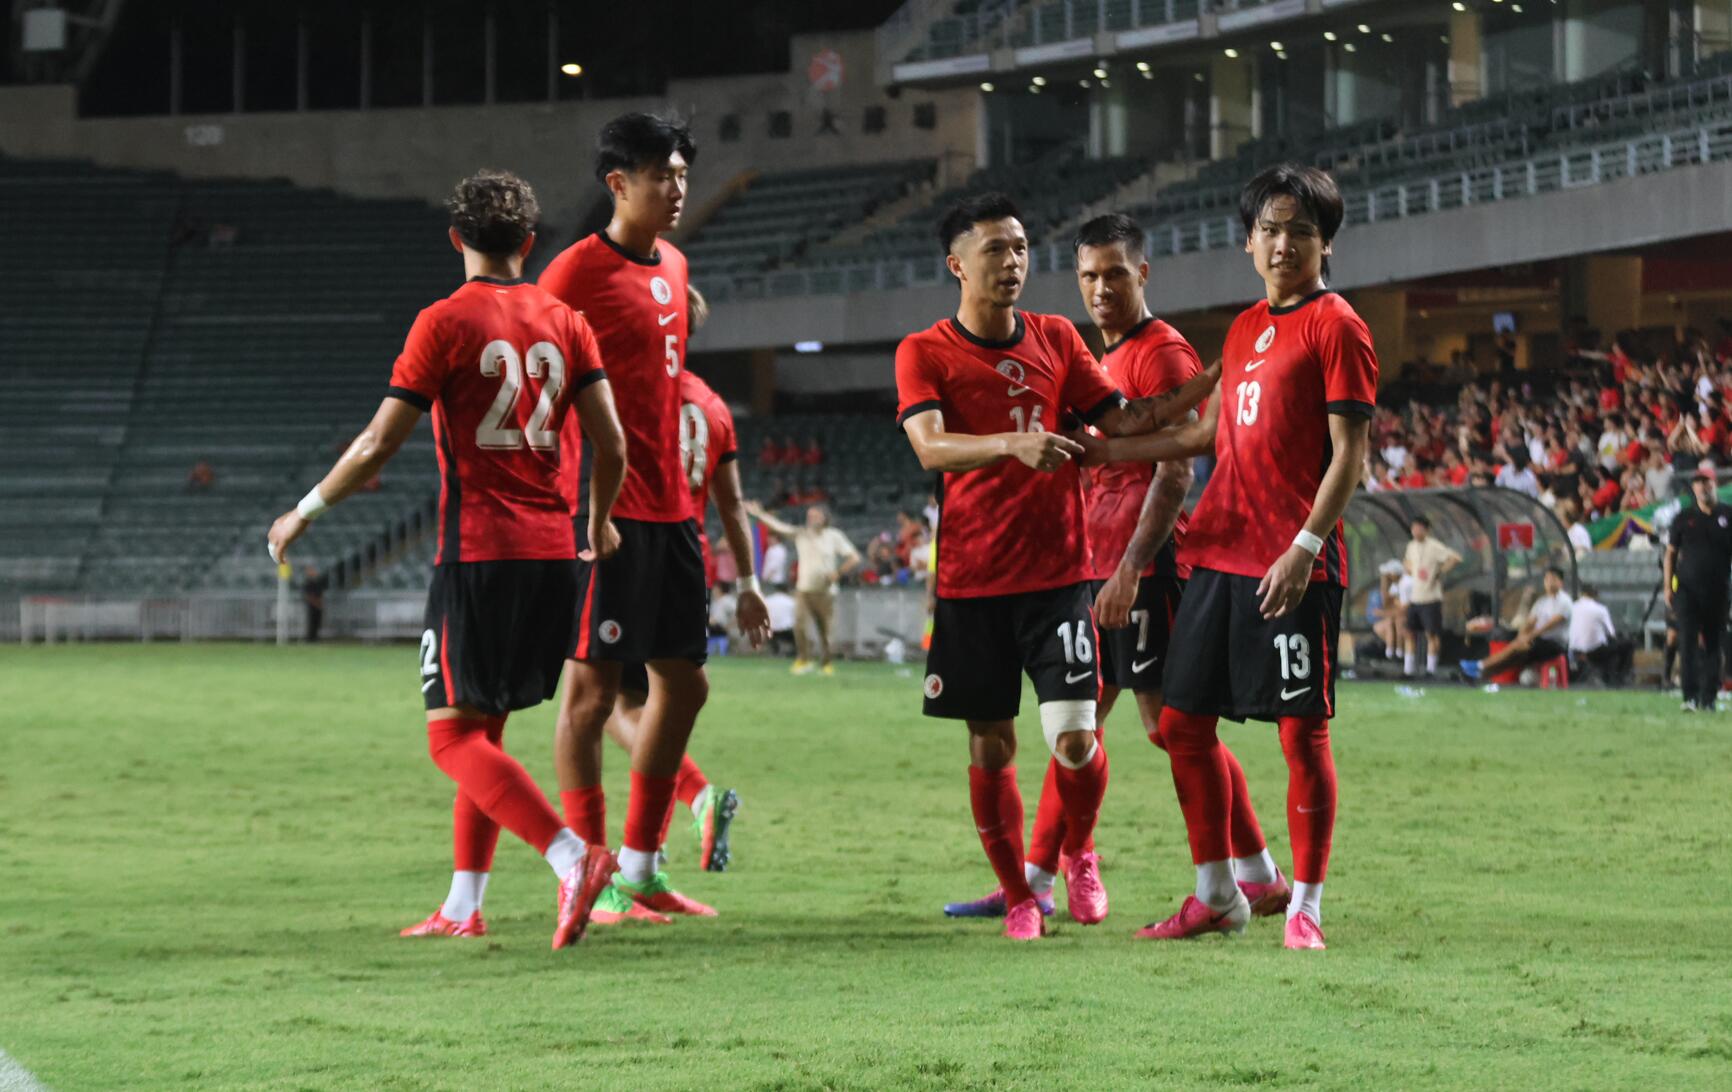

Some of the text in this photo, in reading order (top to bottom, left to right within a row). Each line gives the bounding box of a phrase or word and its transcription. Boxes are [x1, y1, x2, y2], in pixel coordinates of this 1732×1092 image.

[665, 334, 679, 378] 5
[475, 339, 566, 451] 22
[1236, 380, 1261, 426] 13
[1057, 620, 1092, 664] 16
[1131, 609, 1149, 651] 7
[1274, 633, 1311, 680] 13
